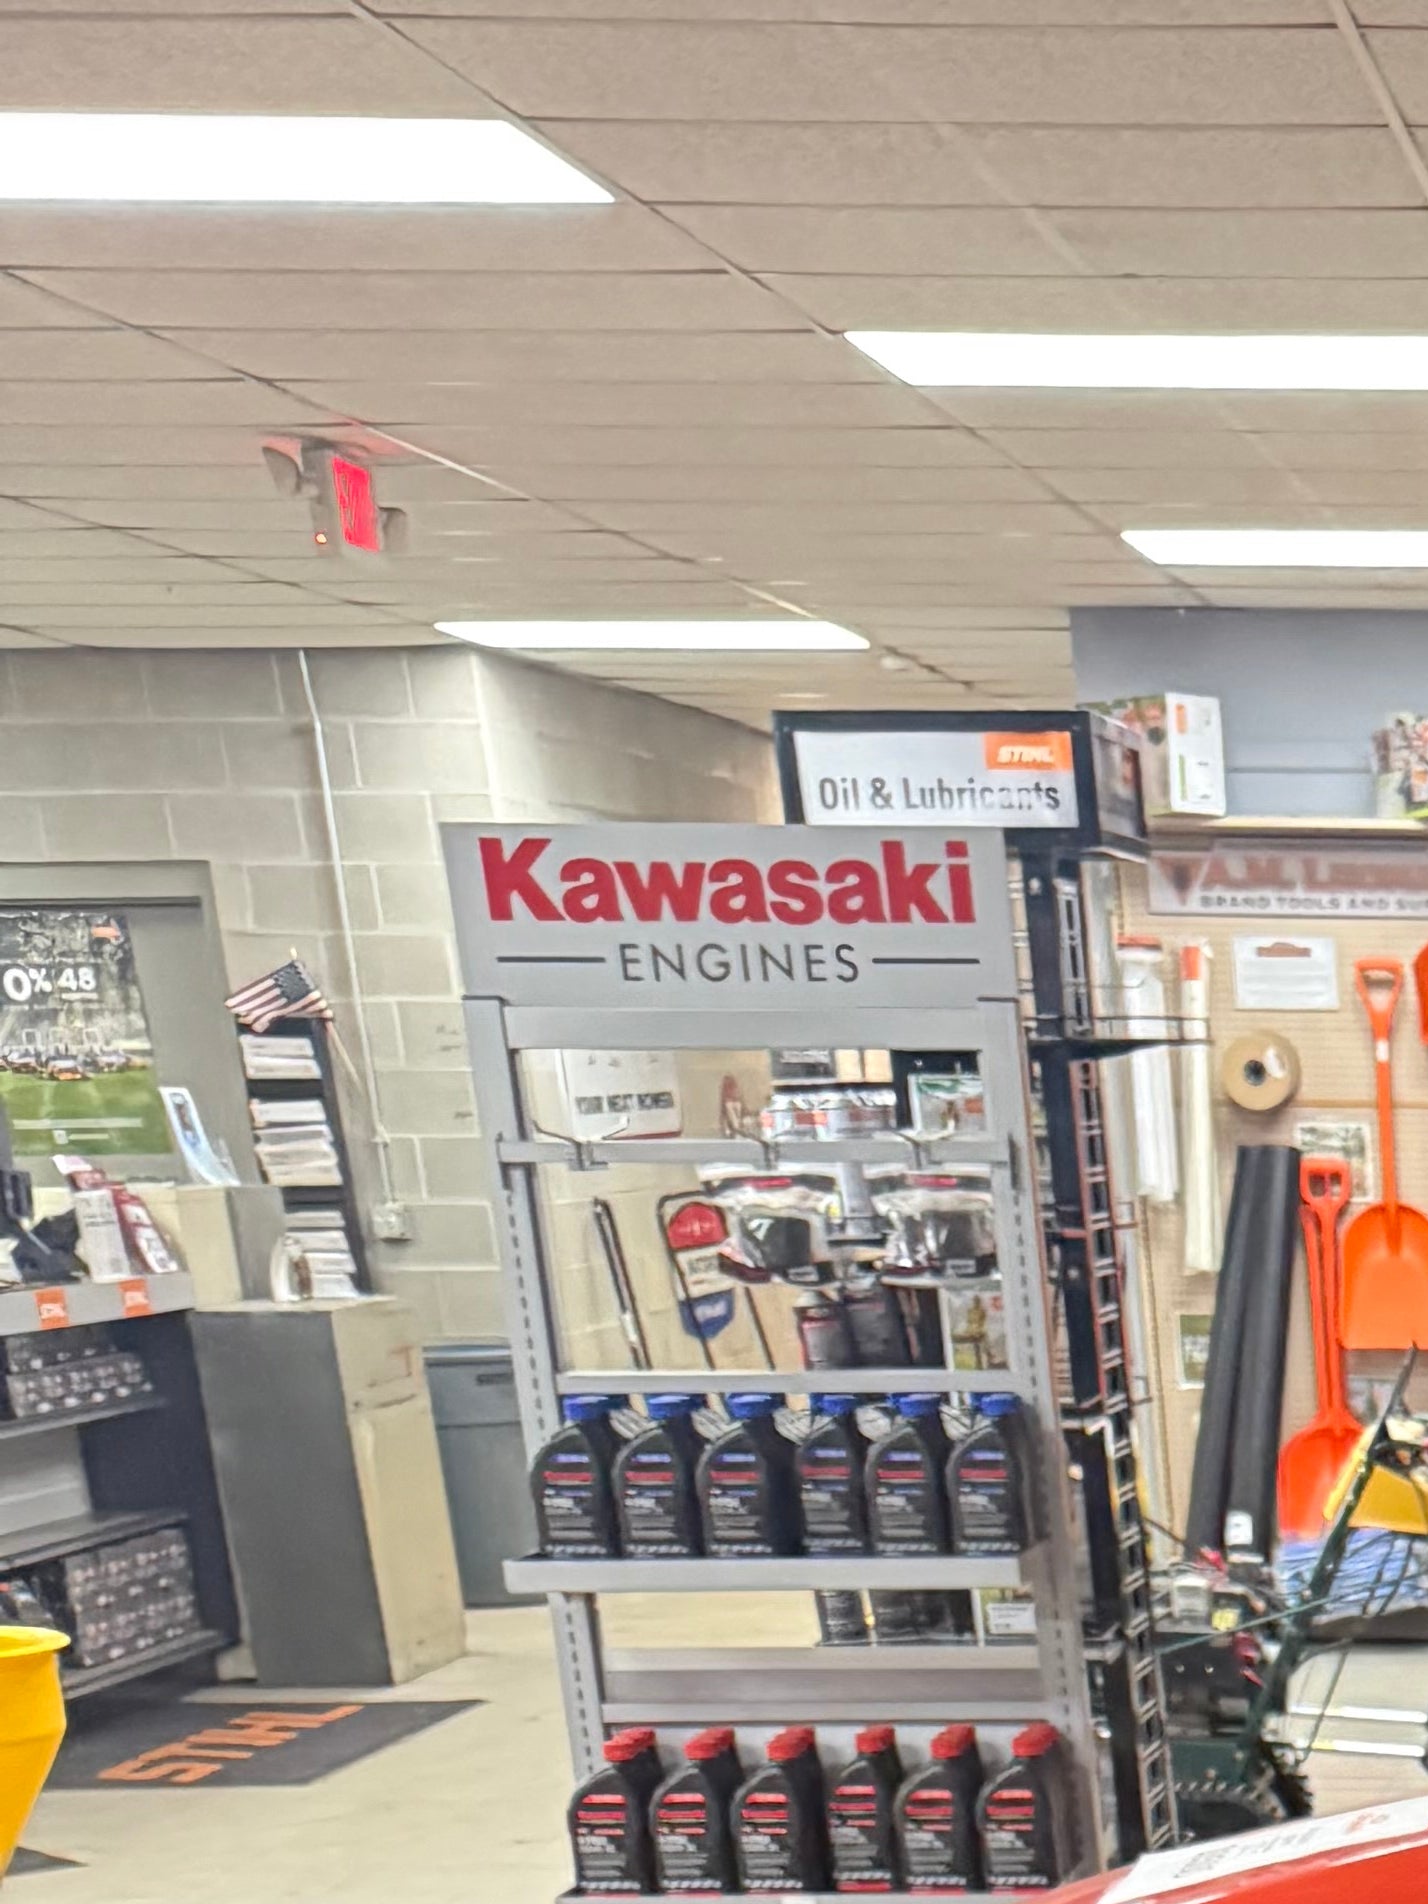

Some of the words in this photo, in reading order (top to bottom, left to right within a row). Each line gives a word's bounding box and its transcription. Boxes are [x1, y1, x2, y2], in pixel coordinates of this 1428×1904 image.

[819, 777, 861, 811] Oil
[870, 777, 894, 811] &
[902, 777, 1060, 811] Lubricants
[478, 837, 976, 925] Kawasaki
[57, 967, 97, 991] 48
[620, 942, 860, 983] ENGINES
[97, 1704, 365, 1785] STIHL
